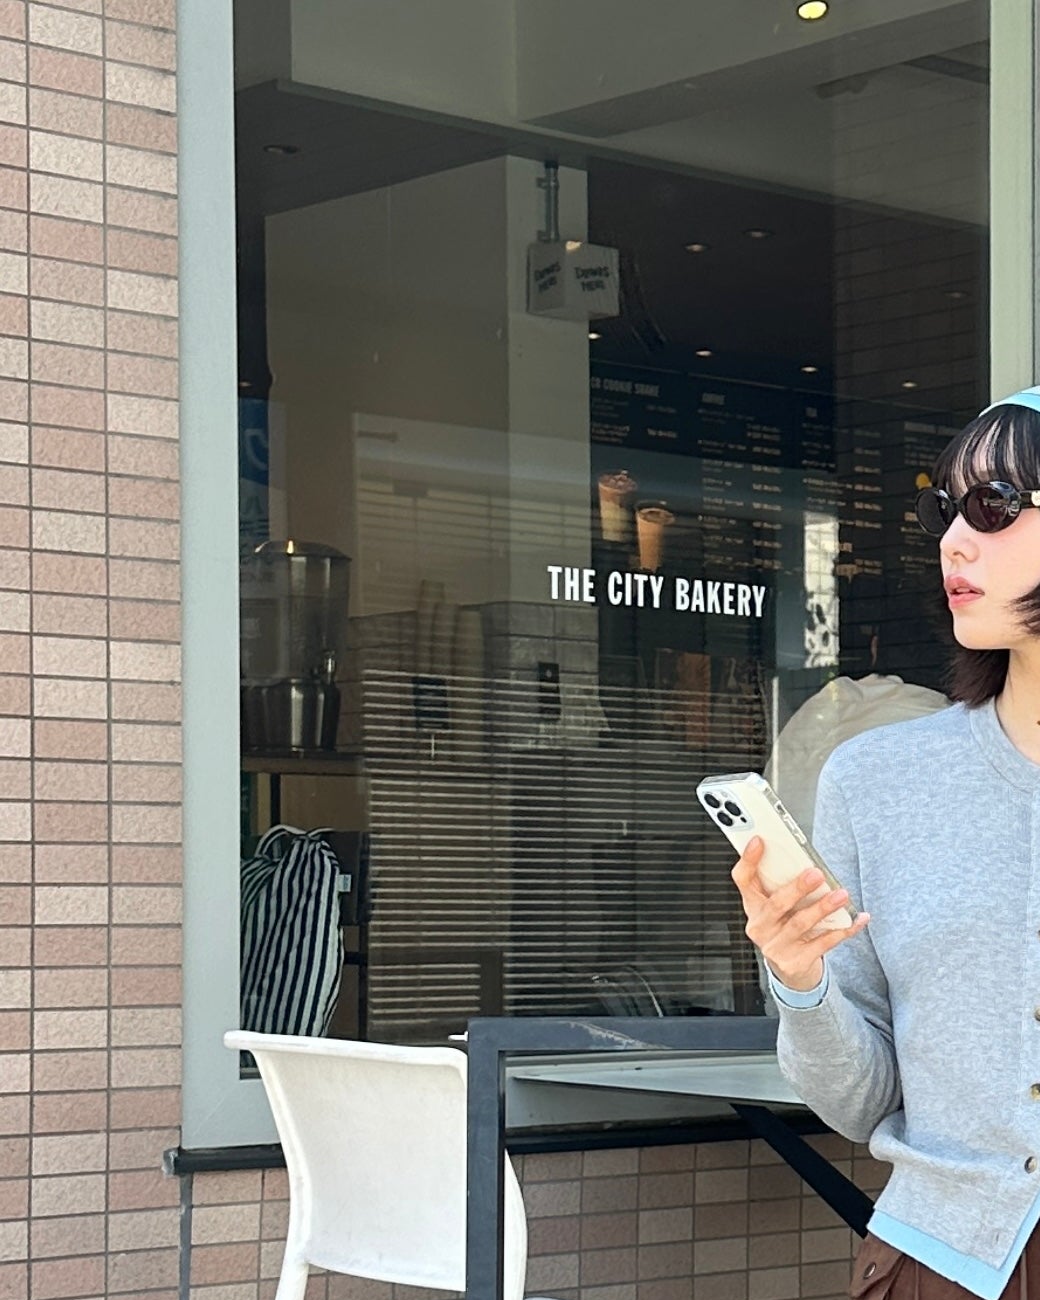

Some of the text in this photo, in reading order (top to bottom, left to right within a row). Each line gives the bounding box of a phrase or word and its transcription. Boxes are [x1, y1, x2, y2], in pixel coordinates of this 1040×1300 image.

[547, 565, 766, 617] THE CITY BAKERY
